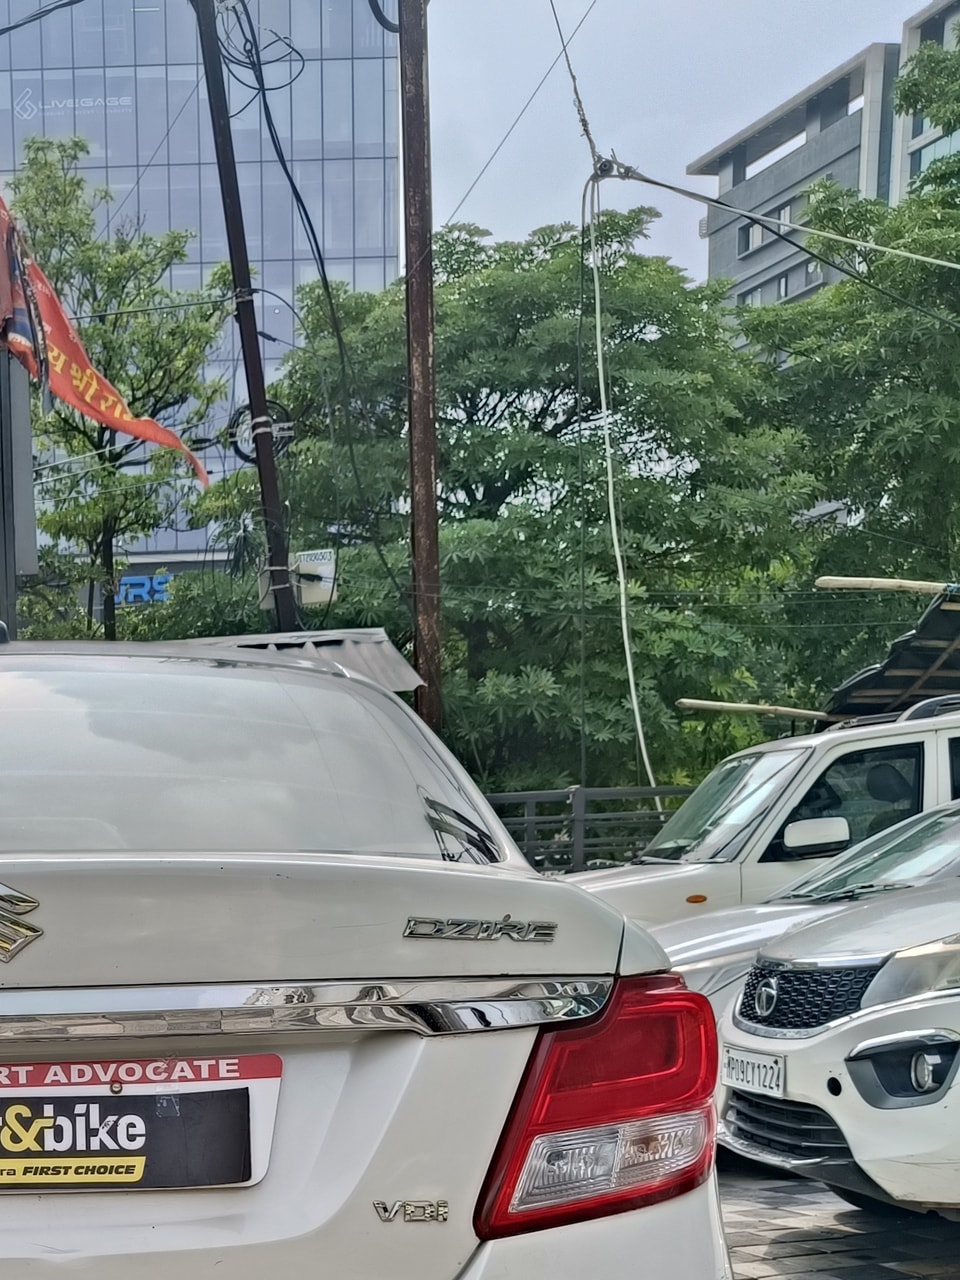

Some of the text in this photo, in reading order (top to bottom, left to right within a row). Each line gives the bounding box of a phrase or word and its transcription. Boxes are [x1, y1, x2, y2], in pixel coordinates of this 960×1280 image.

[403, 915, 558, 943] DZIRE
[43, 1058, 240, 1084] ADVOCATE
[726, 1055, 781, 1092] MP09CY1224
[22, 1165, 72, 1176] FIRST
[73, 1164, 137, 1176] CHOICE
